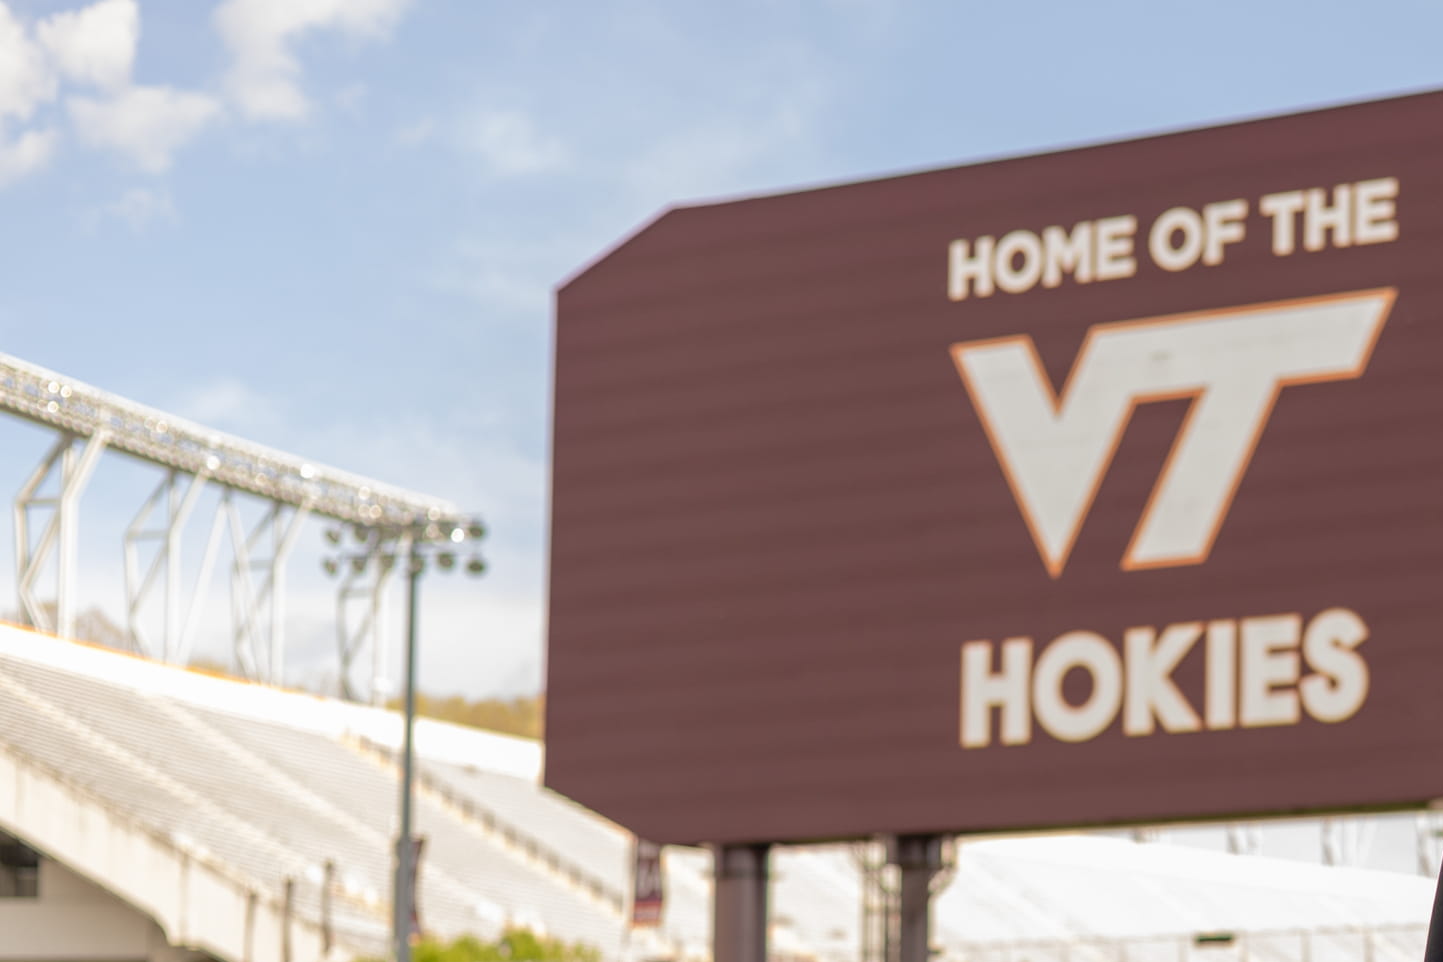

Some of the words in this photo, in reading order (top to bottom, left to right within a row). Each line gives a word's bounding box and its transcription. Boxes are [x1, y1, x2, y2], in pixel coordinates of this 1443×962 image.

[948, 214, 1137, 300] HOME
[1149, 200, 1248, 271] OF
[1260, 178, 1399, 256] THE
[950, 287, 1398, 579] VT
[960, 607, 1370, 748] HOKIES
